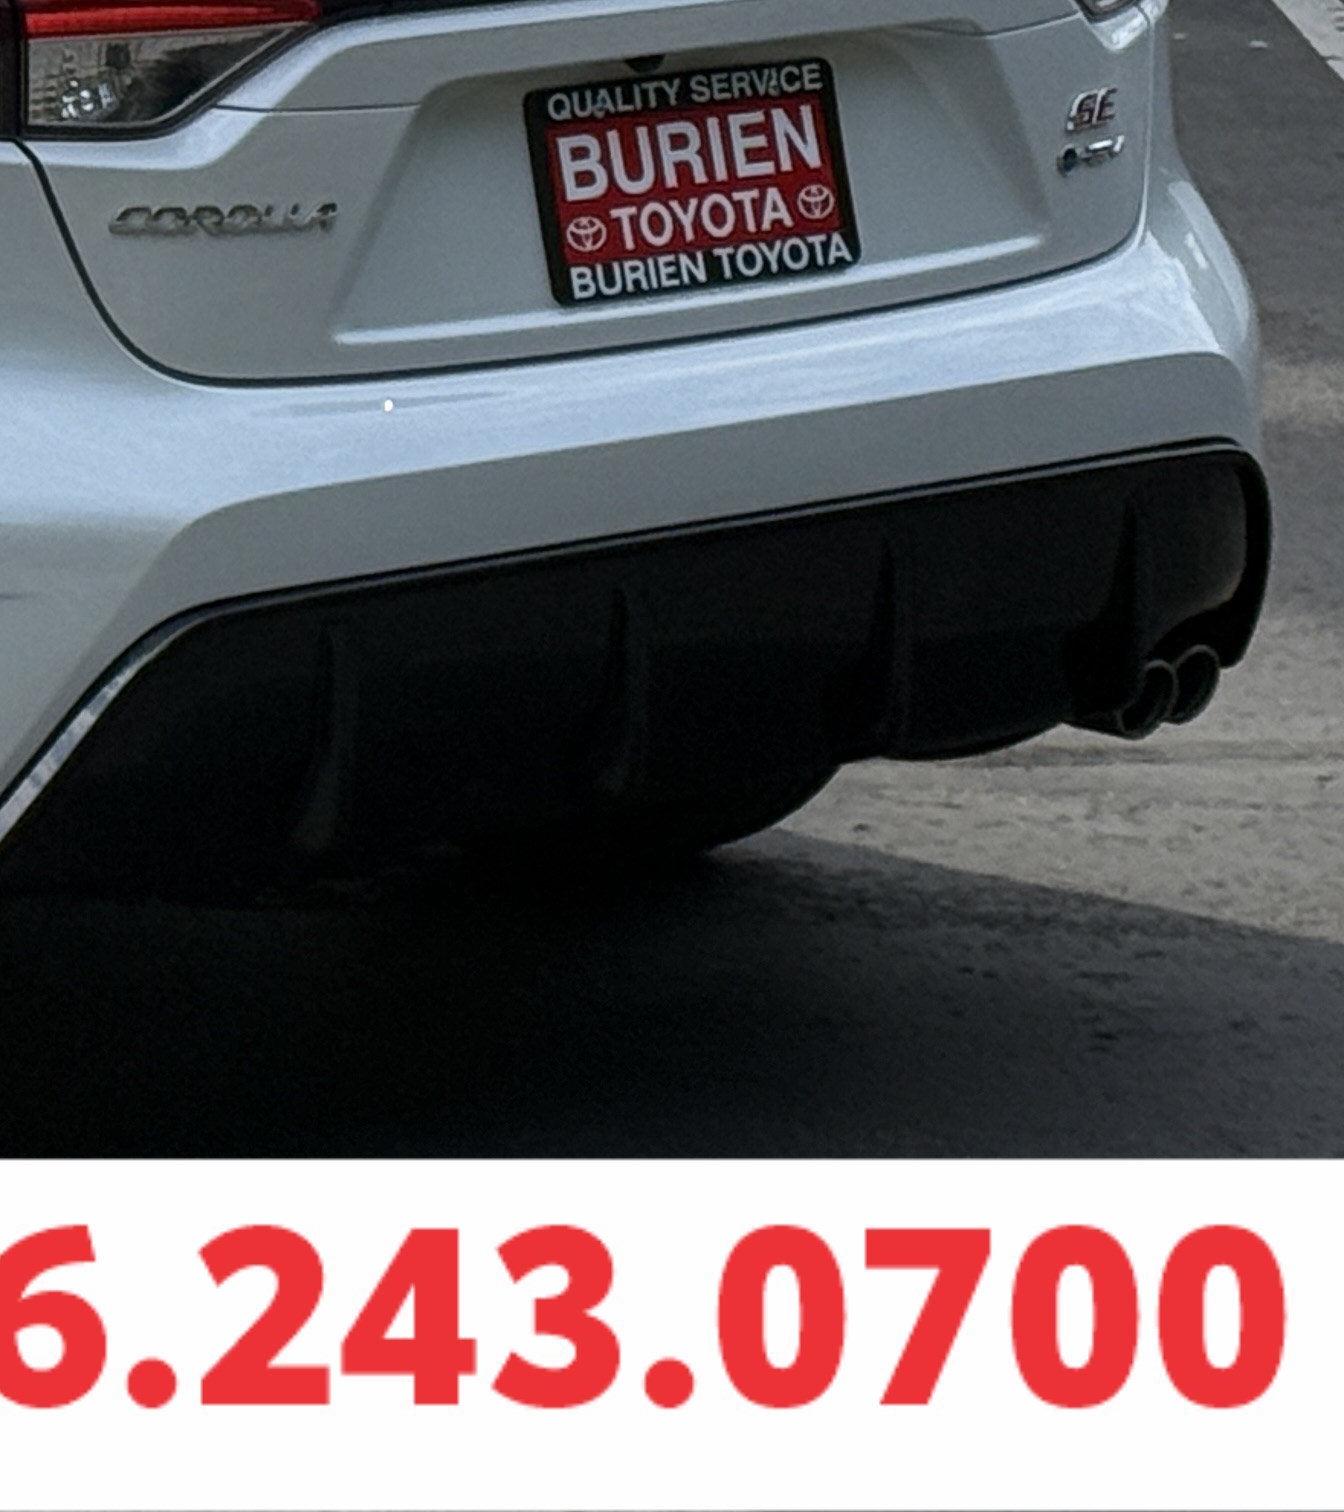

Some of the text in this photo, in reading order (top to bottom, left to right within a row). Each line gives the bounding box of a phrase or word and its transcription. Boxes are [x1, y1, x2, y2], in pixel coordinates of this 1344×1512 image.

[547, 63, 824, 121] QUALITY SERVICE
[556, 104, 824, 203] BURIEN
[610, 187, 794, 251] TOYOTA
[570, 232, 854, 300] BURIEN TOYOTA
